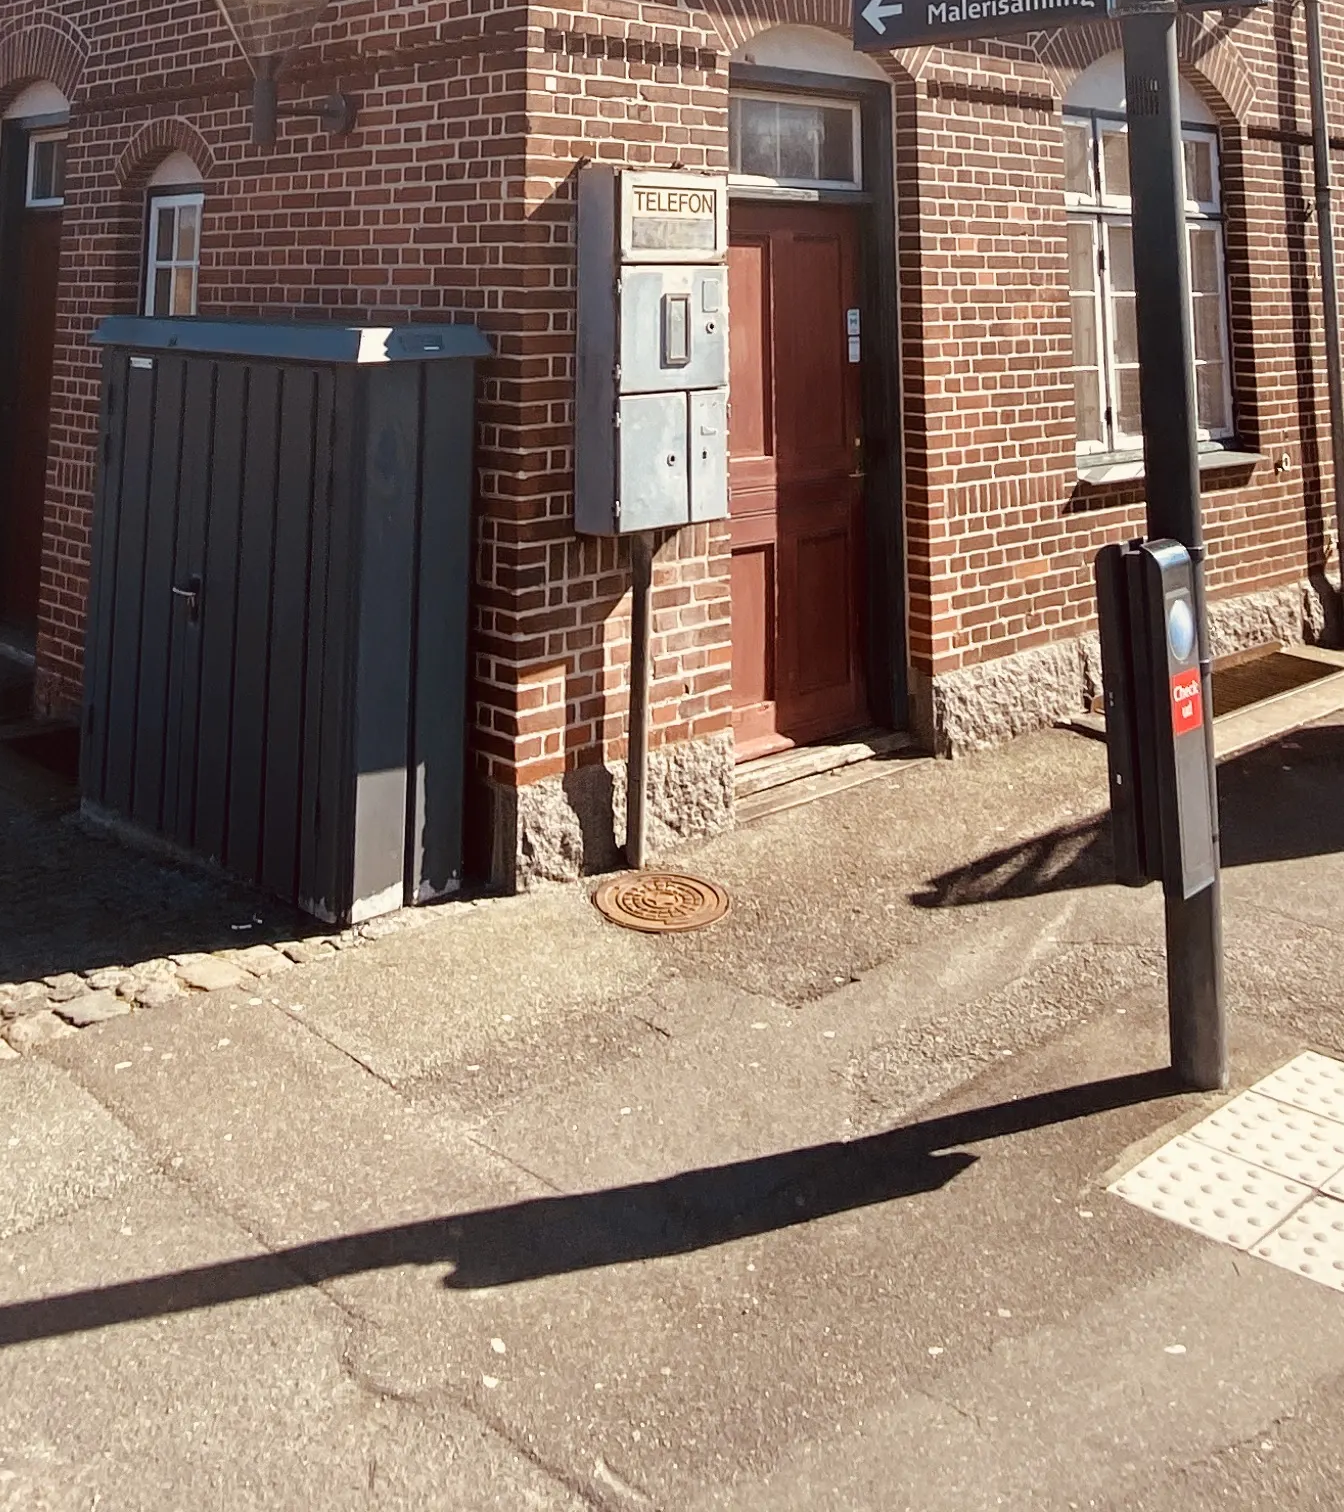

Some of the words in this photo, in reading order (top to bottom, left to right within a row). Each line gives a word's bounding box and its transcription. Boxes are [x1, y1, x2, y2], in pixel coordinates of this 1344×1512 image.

[634, 191, 714, 214] TELEFON
[1173, 680, 1199, 703] Check
[1181, 699, 1194, 719] ud
